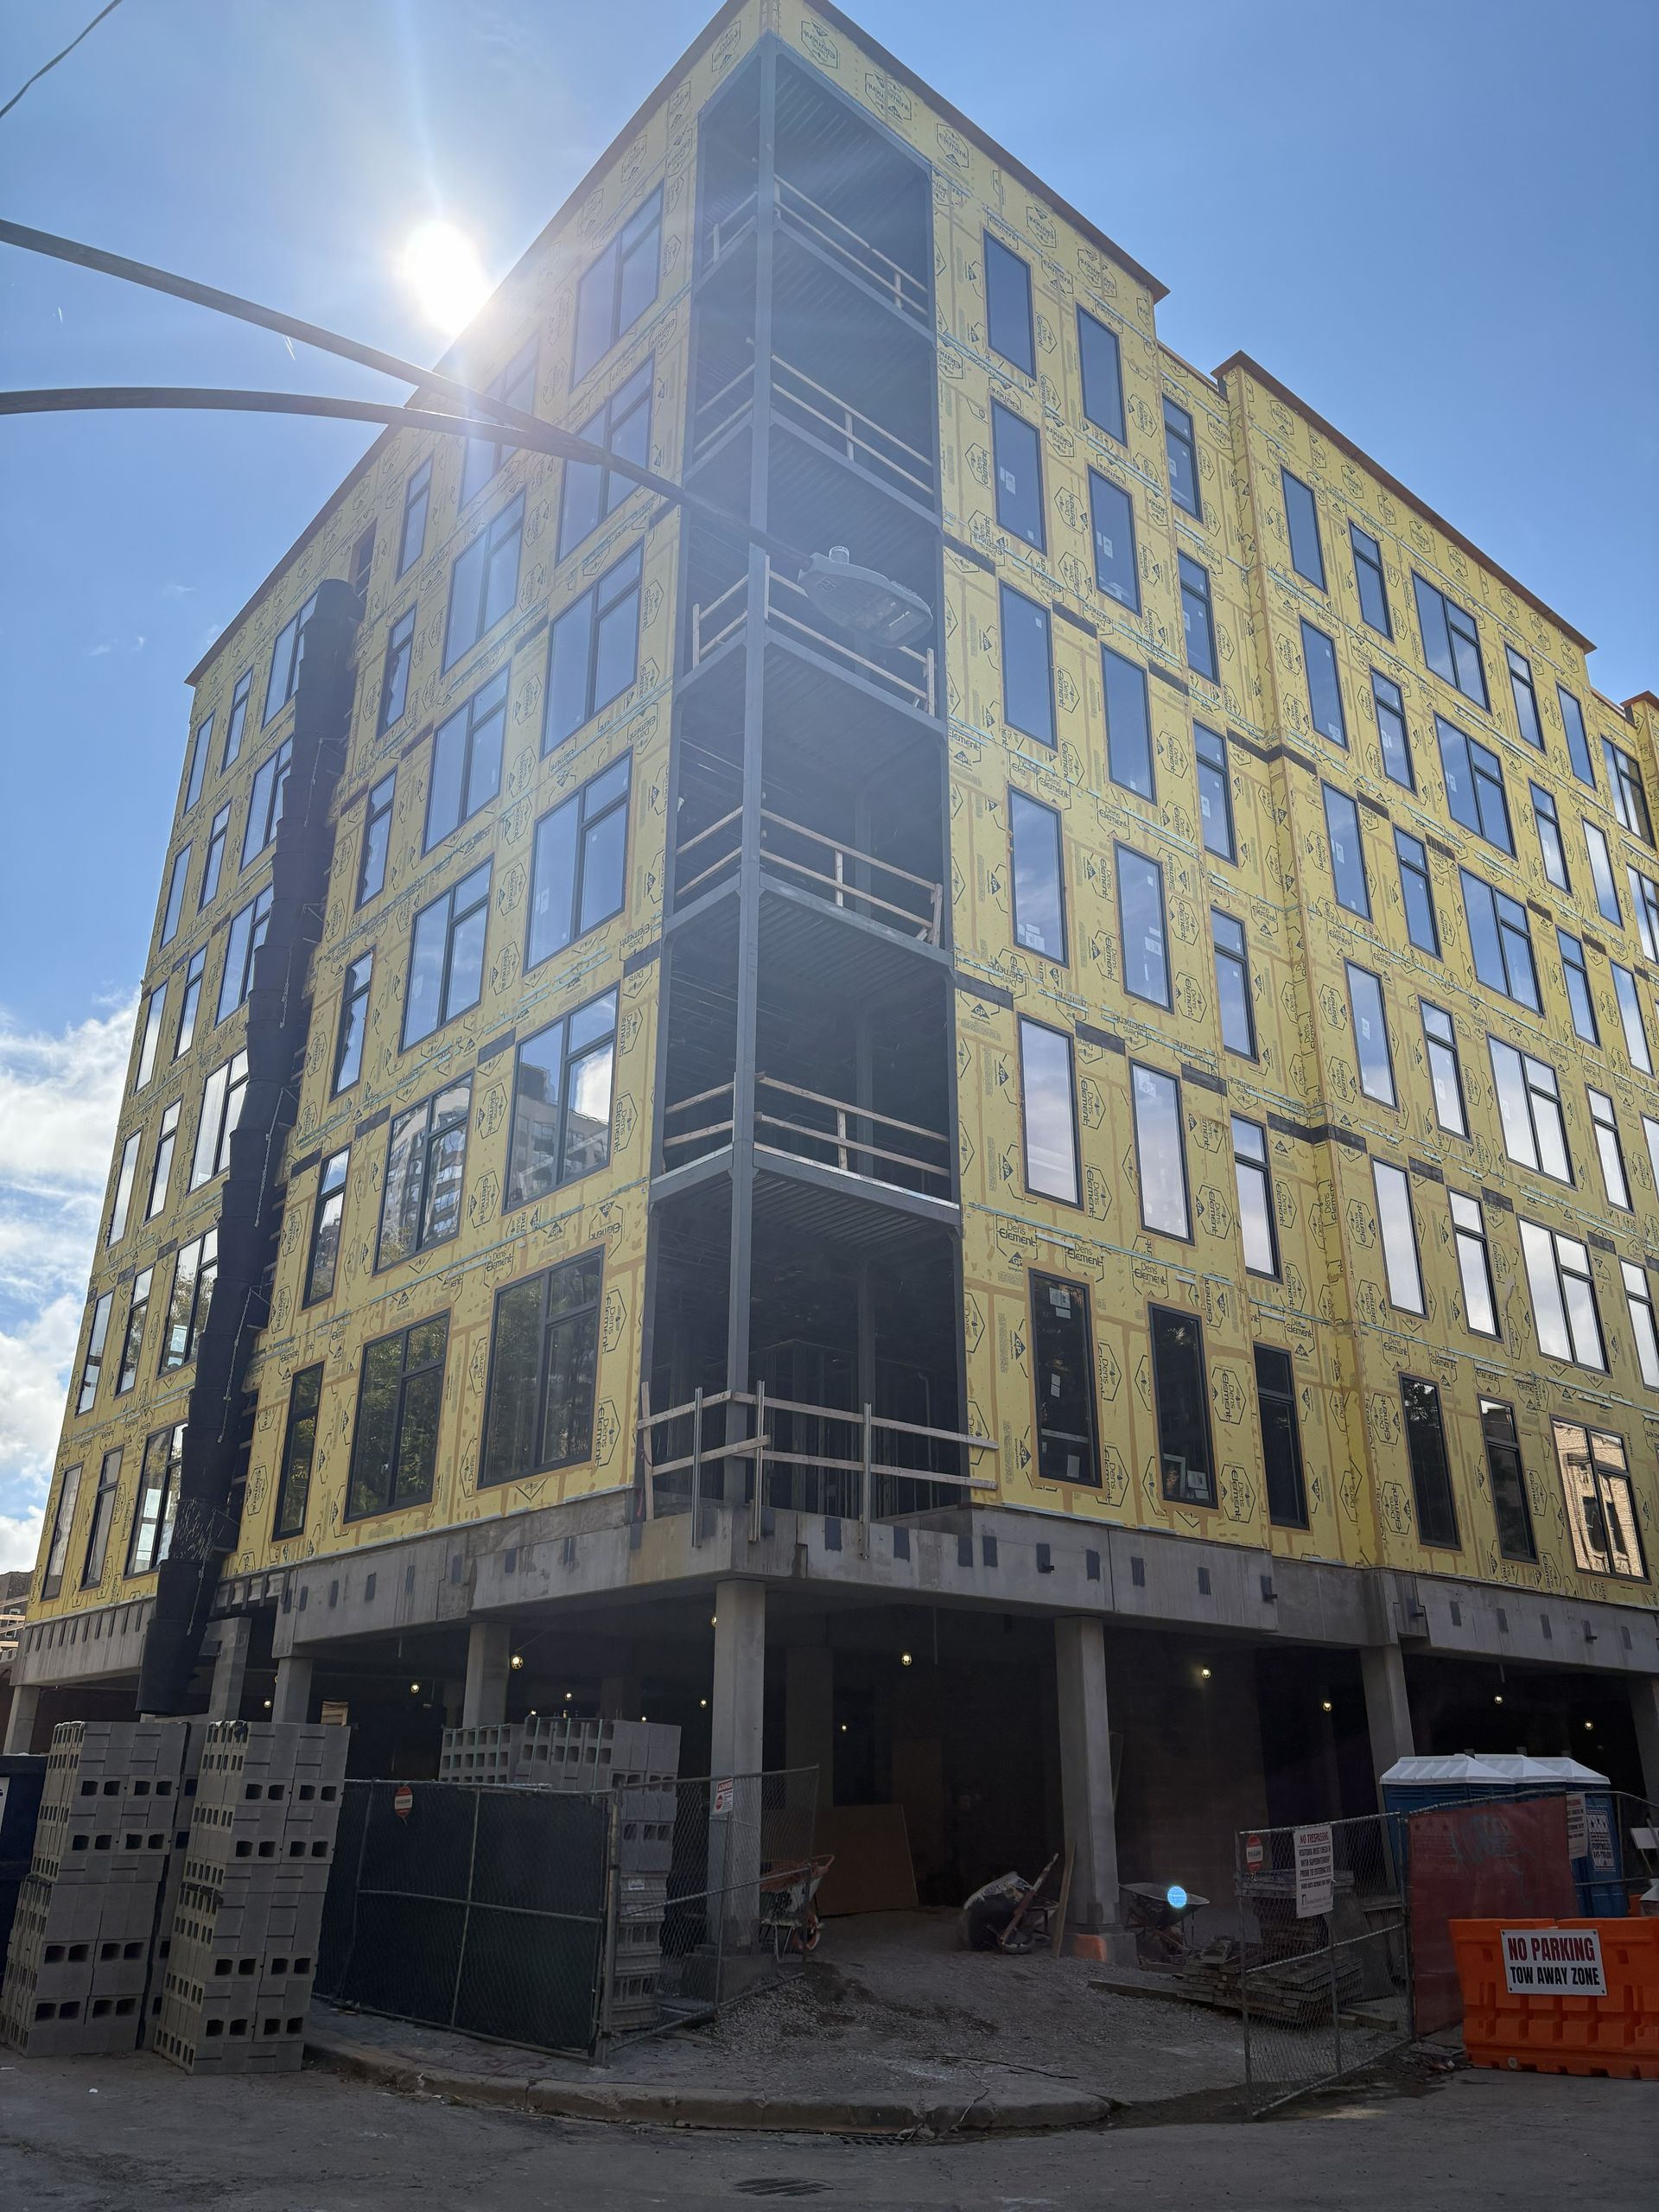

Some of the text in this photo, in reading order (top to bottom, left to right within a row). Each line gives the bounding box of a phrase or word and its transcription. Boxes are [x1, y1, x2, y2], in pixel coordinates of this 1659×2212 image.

[987, 711, 993, 725] GP
[957, 753, 968, 764] GP
[1045, 774, 1062, 788] Dens
[1038, 778, 1071, 799] Element
[1105, 805, 1121, 818] Dens
[1098, 810, 1129, 828] Element
[1087, 867, 1094, 877] GP
[992, 880, 998, 891] GP
[1092, 945, 1098, 957] GP
[1185, 979, 1194, 1017] Element
[975, 1007, 985, 1016] GP
[1000, 1069, 1005, 1082] GP
[1339, 1062, 1348, 1098] Element
[488, 1090, 497, 1134] Element
[614, 1102, 623, 1153] Element
[1004, 1162, 1009, 1177] GP
[1087, 1165, 1096, 1218] Element
[480, 1178, 488, 1223] Element
[1197, 1201, 1202, 1214] GP
[1007, 1223, 1027, 1236] Dens
[1357, 1202, 1366, 1243] Element
[1369, 1223, 1375, 1234] GP
[999, 1229, 1037, 1247] Element
[1075, 1243, 1092, 1255] Dens
[486, 1256, 513, 1271] Element
[493, 1251, 506, 1262] Dens
[1013, 1257, 1022, 1266] GP
[1067, 1249, 1103, 1267] Element
[1492, 1244, 1502, 1282] Element
[1141, 1262, 1158, 1274] Dens
[1135, 1271, 1167, 1286] Element
[1286, 1266, 1294, 1309] Element
[399, 1295, 409, 1304] GP
[1218, 1298, 1224, 1307] GP
[1368, 1284, 1376, 1323] Element
[1453, 1306, 1459, 1318] GP
[1285, 1325, 1313, 1338] Element
[1016, 1339, 1022, 1355] GP
[1383, 1343, 1408, 1356] Element
[1223, 1372, 1231, 1421] Element
[1304, 1392, 1309, 1405] GP
[1381, 1398, 1391, 1440] Element
[1393, 1416, 1400, 1427] GP
[595, 1407, 605, 1466] Element
[1021, 1449, 1027, 1464] GP
[1478, 1471, 1484, 1484] GP
[1231, 1471, 1241, 1521] Element
[1313, 1484, 1319, 1497] GP
[1529, 1473, 1538, 1514] Element
[1391, 1486, 1402, 1531] Element
[1405, 1505, 1410, 1516] GP
[1300, 1835, 1306, 1844] NO
[1508, 1938, 1595, 1961] NO PARKING
[1510, 1967, 1599, 1985] TOW AWAY ZONE
